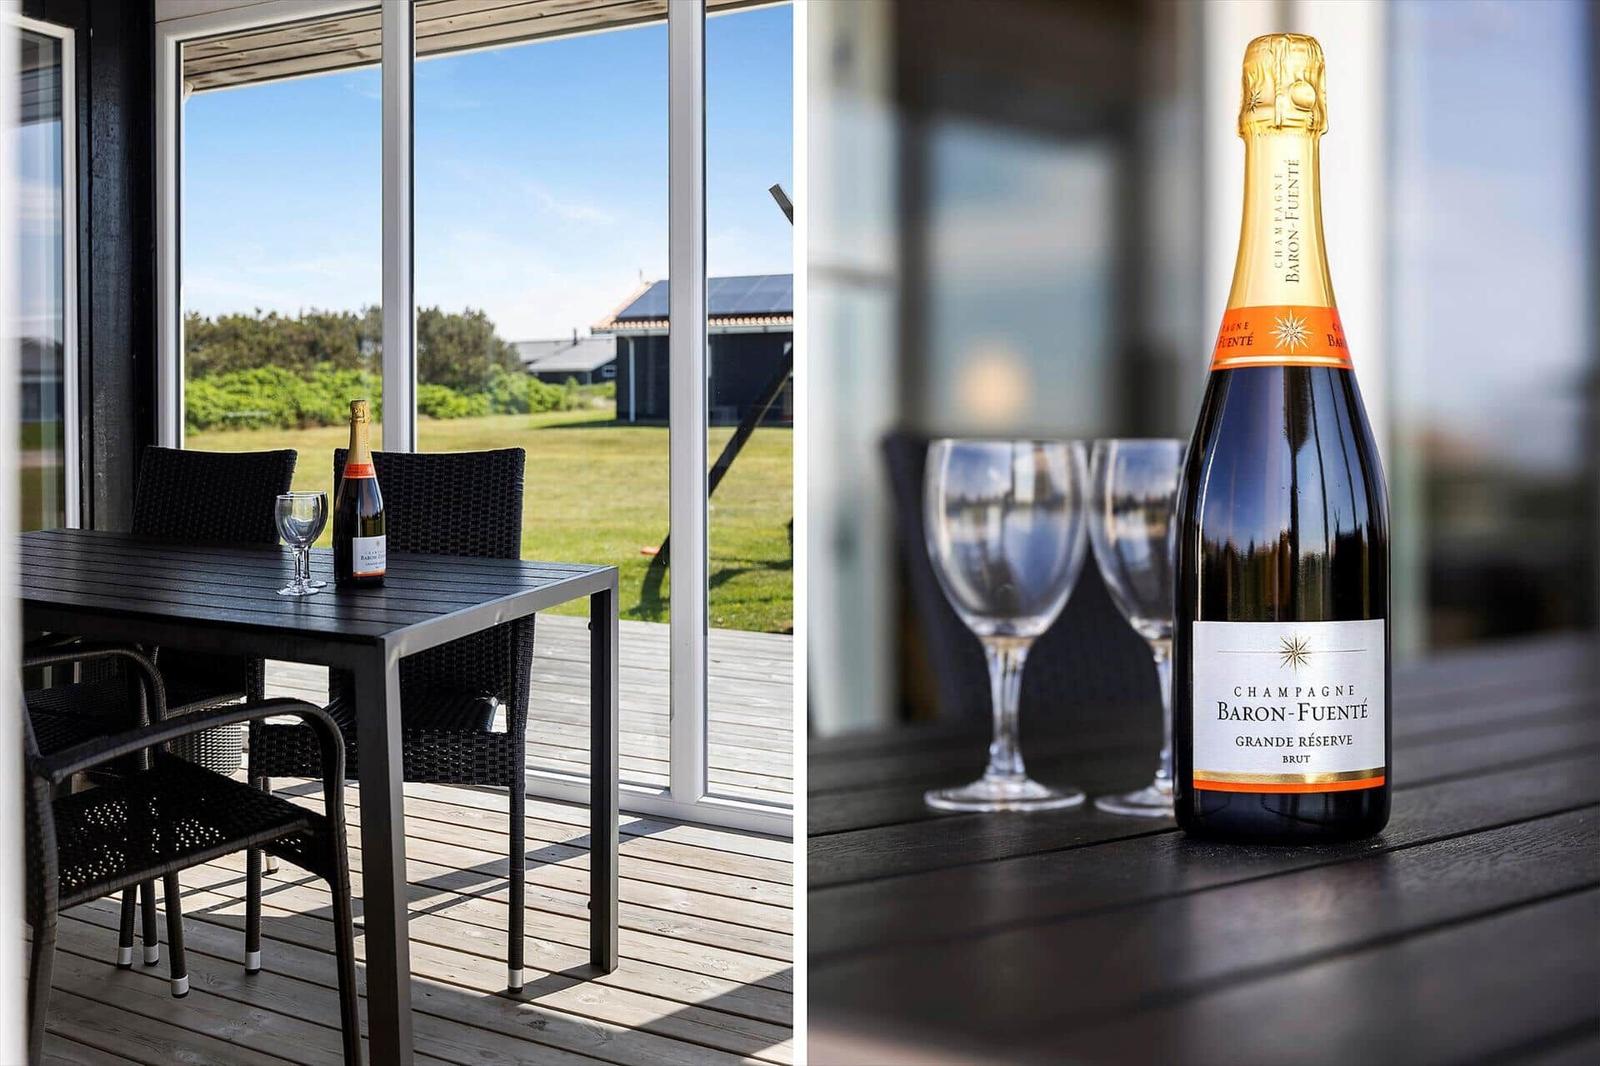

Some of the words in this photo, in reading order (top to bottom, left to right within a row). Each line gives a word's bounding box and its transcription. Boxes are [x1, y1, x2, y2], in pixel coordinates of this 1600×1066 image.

[1274, 172, 1283, 269] CHAMPAGNE
[1234, 685, 1355, 698] CHAMPAGNE
[1217, 697, 1369, 722] BARON-FUENTÉ
[1235, 735, 1294, 748] GRANDE
[1299, 732, 1353, 748] RÉSERVE
[1282, 755, 1311, 764] BRUT
